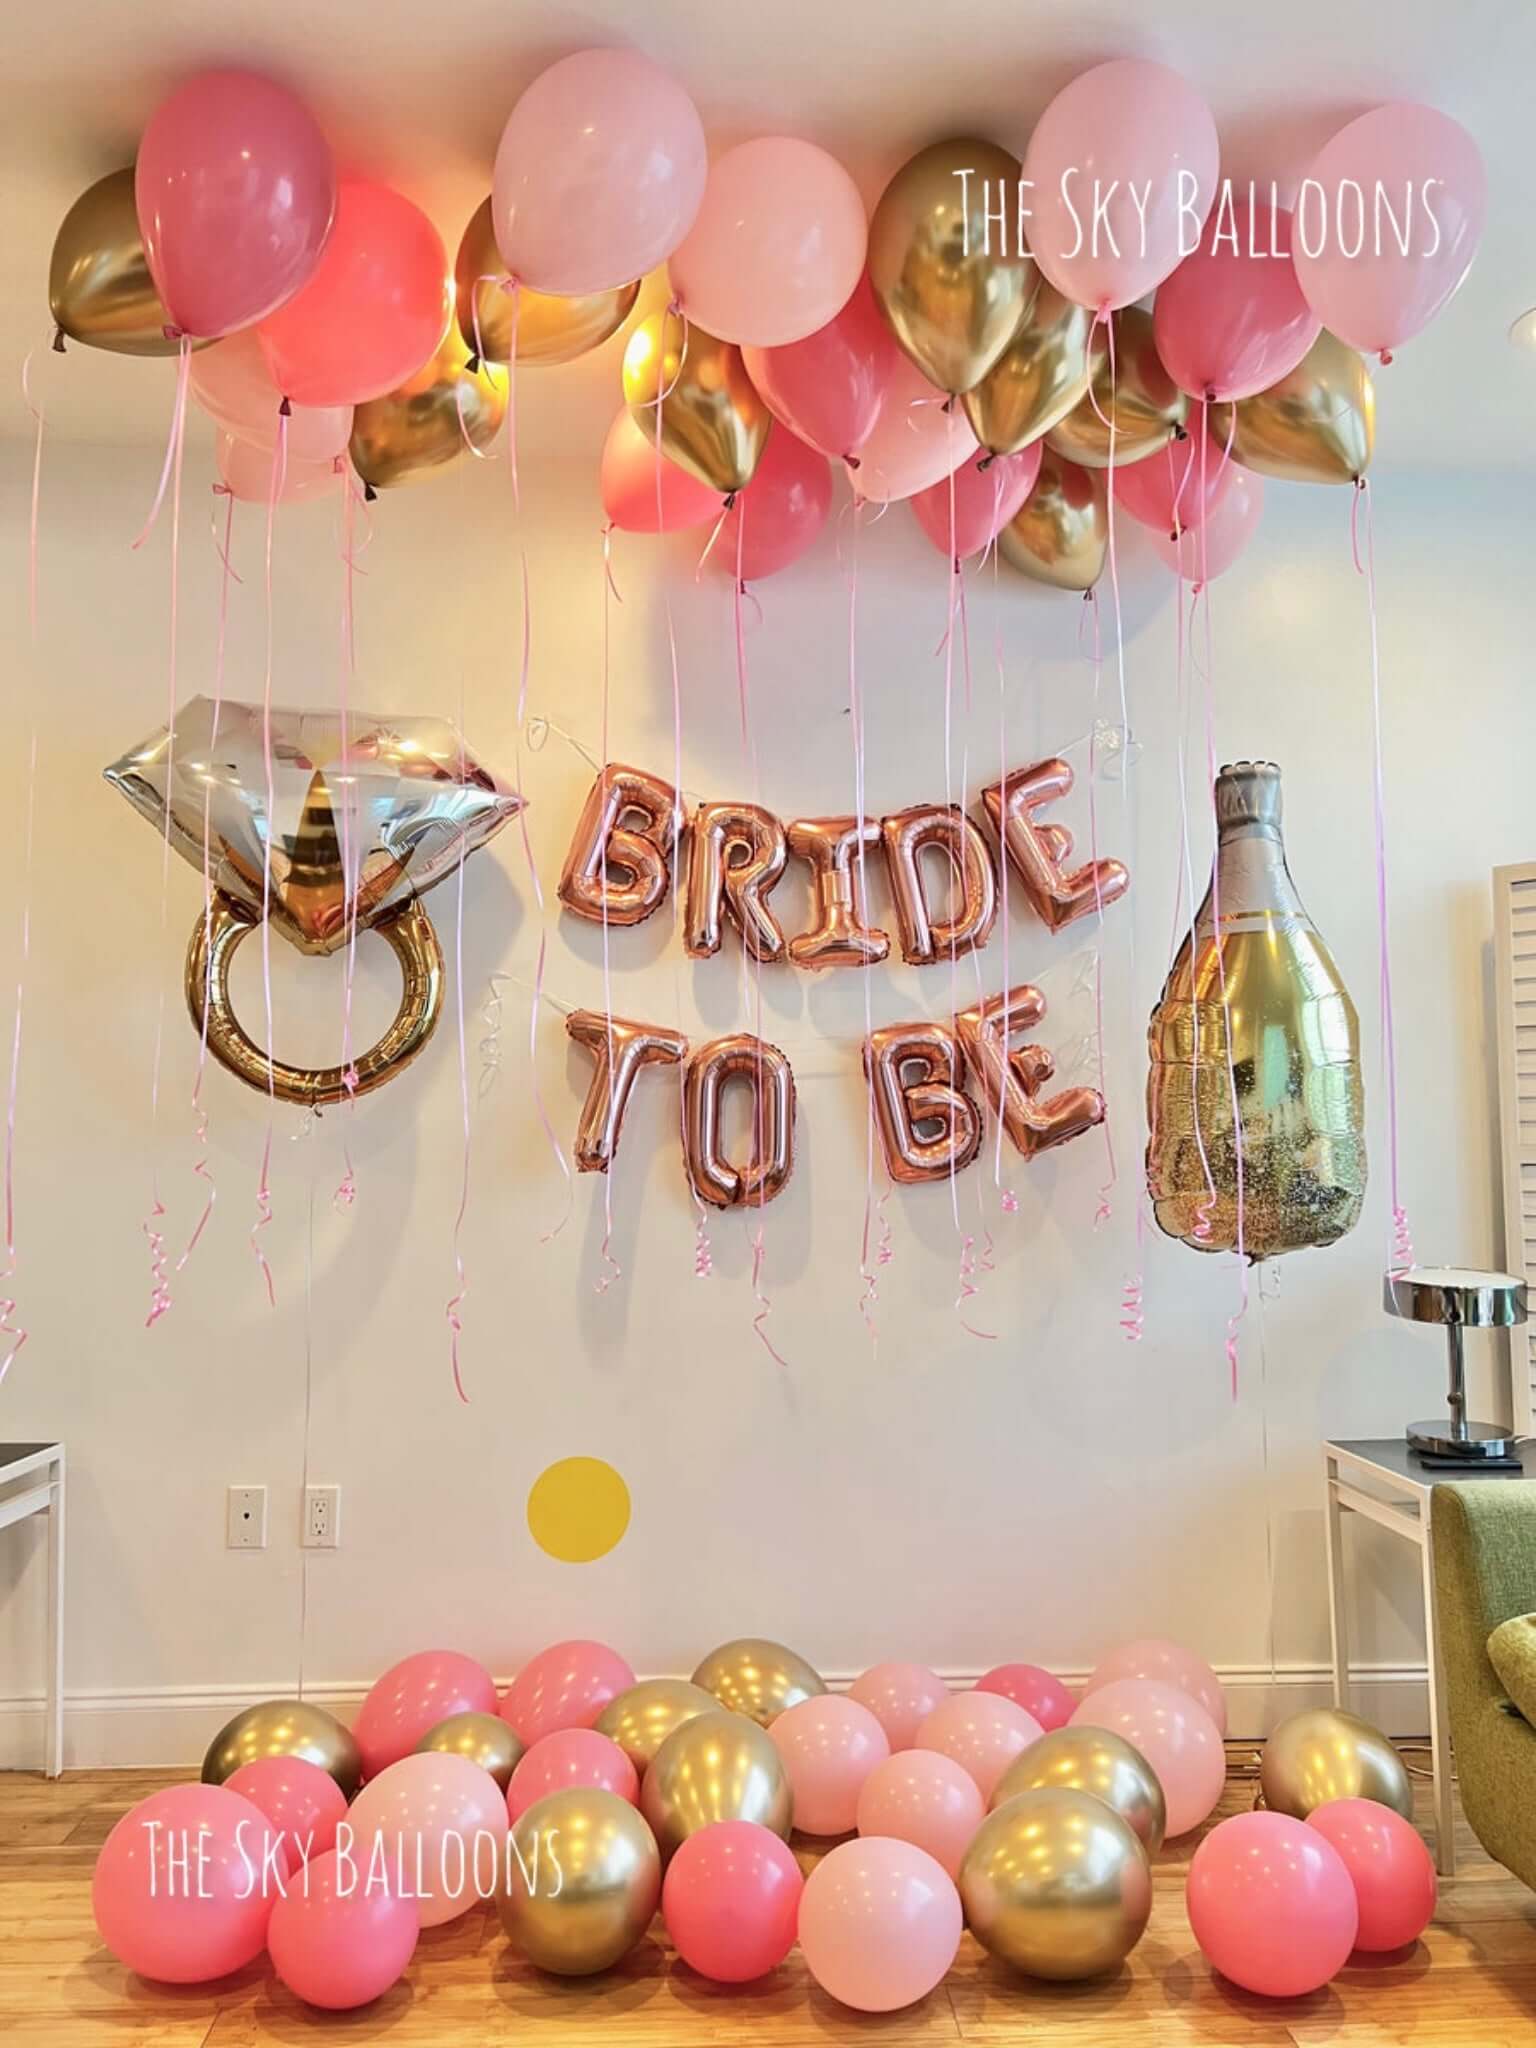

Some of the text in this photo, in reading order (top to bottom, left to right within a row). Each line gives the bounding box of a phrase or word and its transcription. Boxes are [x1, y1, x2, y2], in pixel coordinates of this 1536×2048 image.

[557, 758, 1131, 970] BRIDE
[565, 984, 1107, 1210] TO BE
